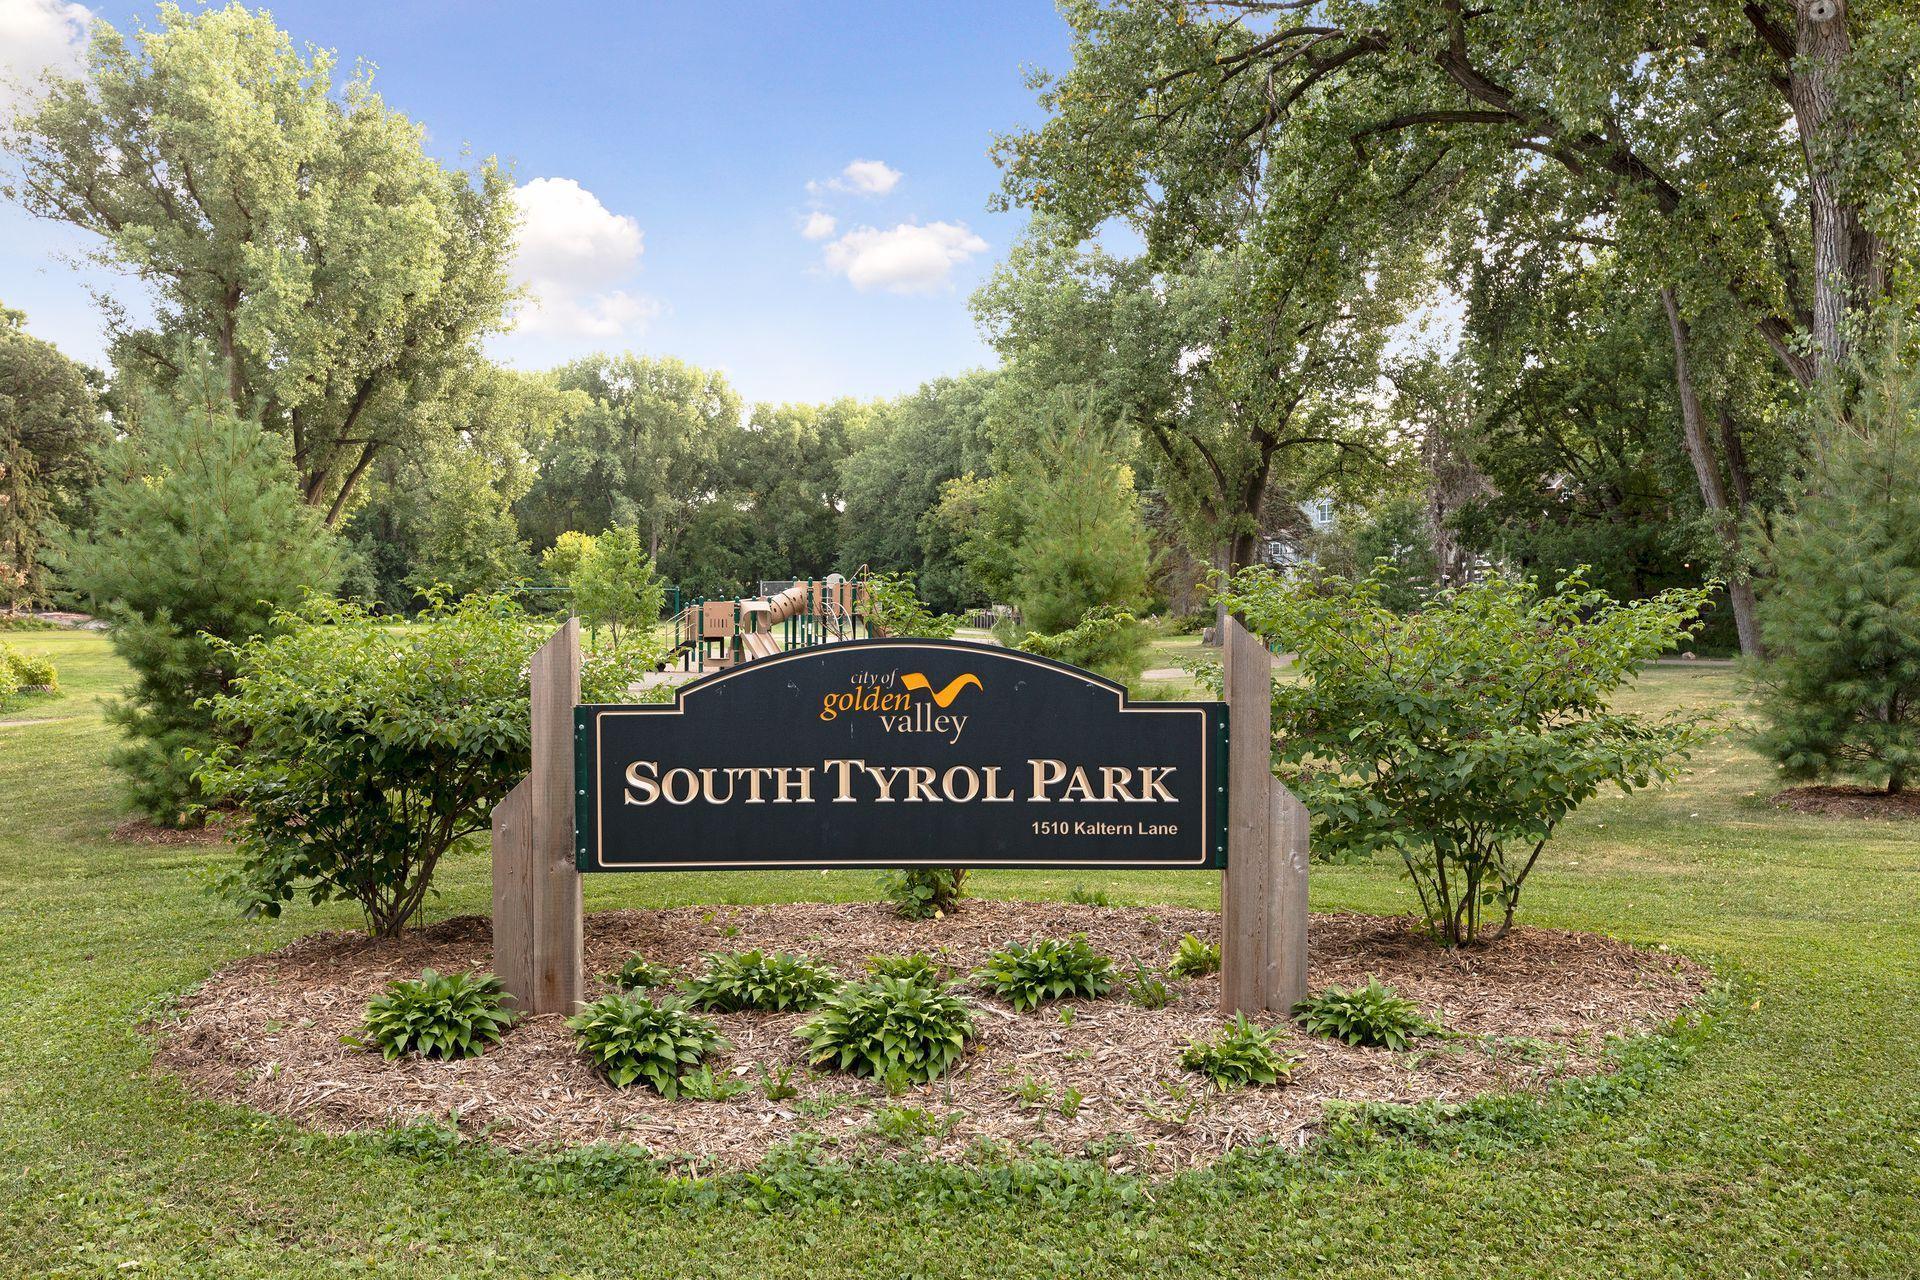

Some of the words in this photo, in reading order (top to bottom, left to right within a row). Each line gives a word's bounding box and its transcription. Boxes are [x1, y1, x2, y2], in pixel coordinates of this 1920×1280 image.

[850, 671, 878, 690] city
[881, 668, 899, 690] of
[819, 685, 912, 722] golden
[880, 702, 969, 745] valley
[623, 759, 815, 805] SOUTH
[823, 758, 1015, 803] TYROL
[1026, 758, 1180, 803] PARK
[1031, 821, 1069, 835] 1510
[1074, 821, 1133, 835] Kaltern
[1138, 821, 1178, 835] Lane
